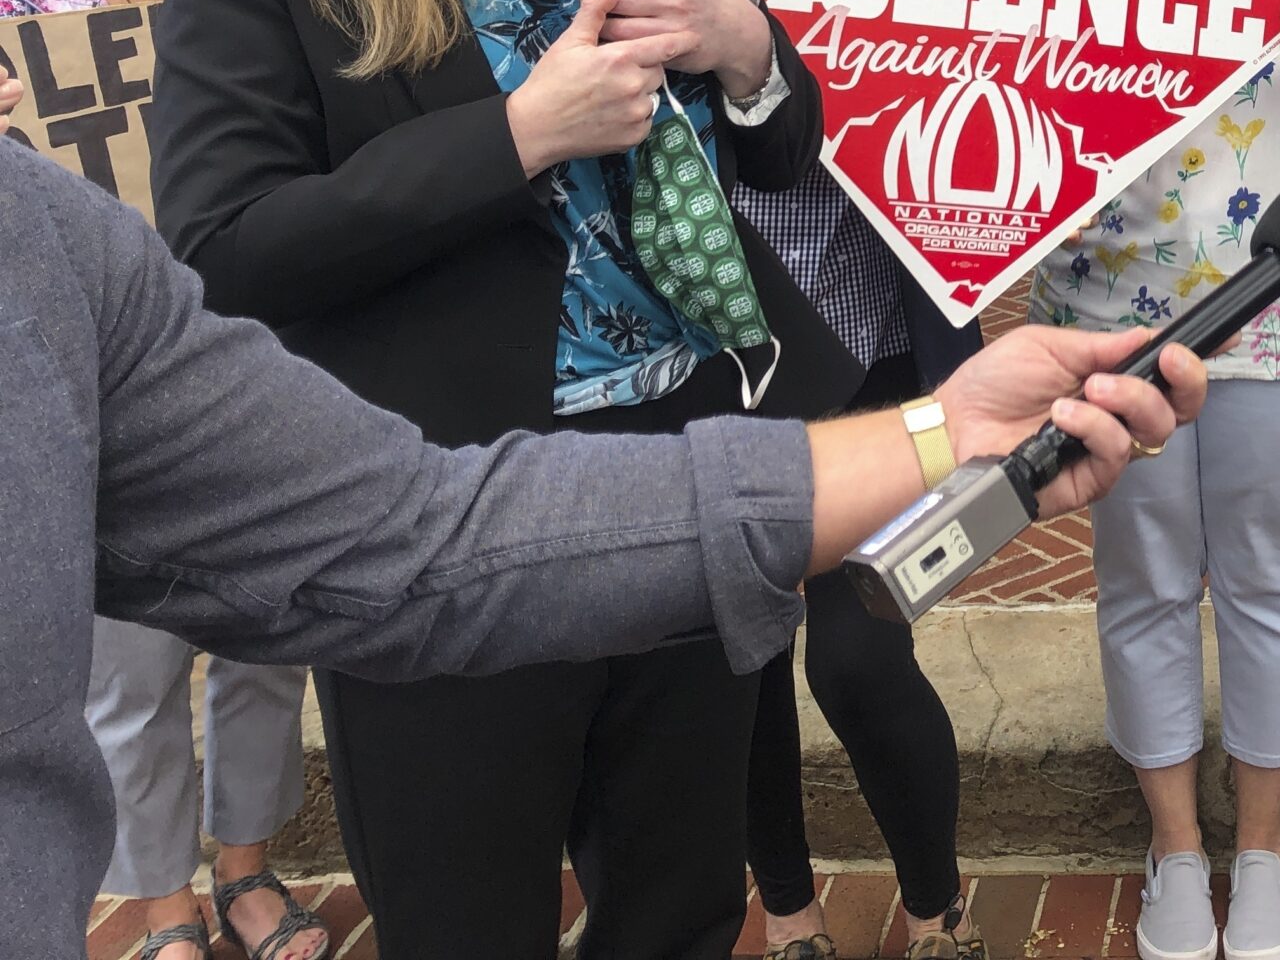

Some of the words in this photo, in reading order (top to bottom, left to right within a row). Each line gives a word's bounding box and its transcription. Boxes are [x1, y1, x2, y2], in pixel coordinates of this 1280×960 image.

[797, 5, 1019, 90] Against
[1014, 24, 1195, 102] Women
[883, 80, 1064, 213] NOW
[677, 163, 689, 182] YES
[684, 159, 700, 180] ERA
[690, 195, 703, 216] YES
[698, 193, 715, 214] ERA
[895, 206, 1041, 228] NATIONAL
[703, 230, 717, 250] YES
[712, 228, 728, 247] ERA
[904, 223, 1027, 241] ORGANIZATION
[922, 238, 950, 249] FOR
[953, 239, 1010, 253] WOMEN
[716, 264, 729, 285] YES
[724, 262, 741, 282] ERA
[728, 298, 741, 317] YES
[736, 296, 753, 316] ERA
